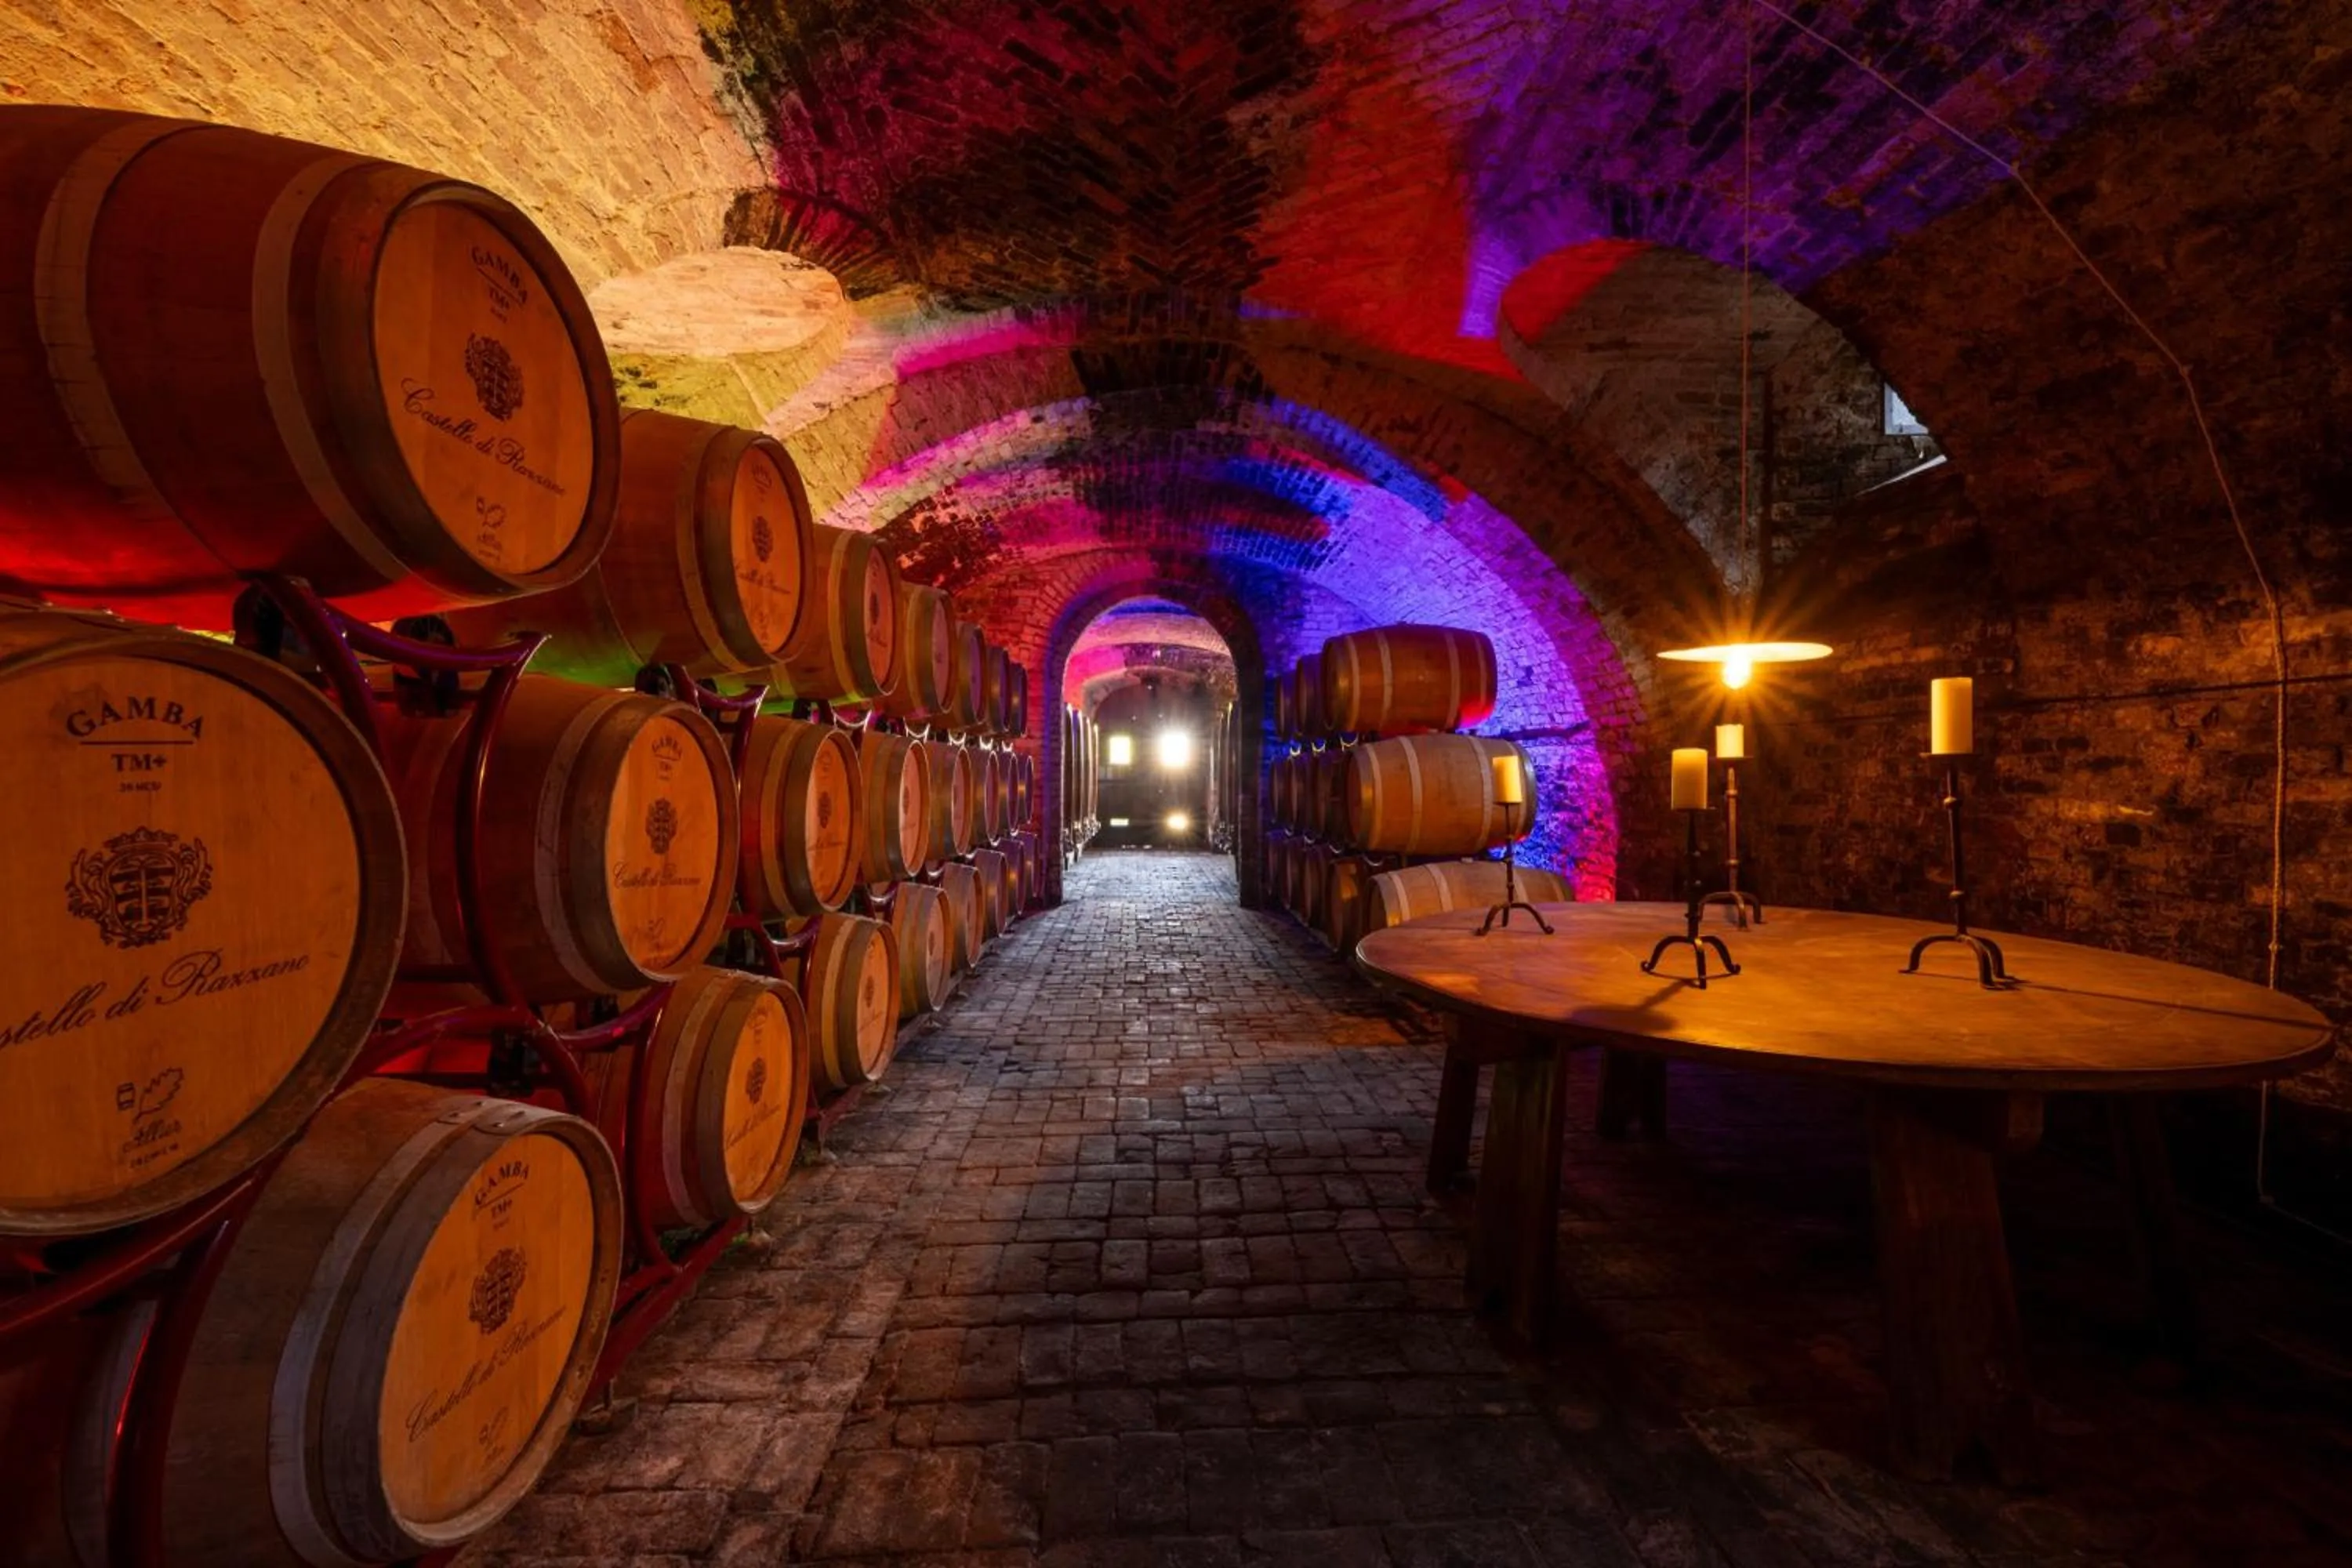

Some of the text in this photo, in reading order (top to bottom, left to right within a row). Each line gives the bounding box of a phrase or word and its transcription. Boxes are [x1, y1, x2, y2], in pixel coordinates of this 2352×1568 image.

[471, 245, 528, 304] GAMBA
[401, 377, 478, 444] Castello
[474, 434, 496, 456] di
[66, 696, 204, 739] GAMBA
[111, 753, 168, 771] TM+
[105, 975, 150, 1020] di
[156, 948, 310, 1004] Razzano
[474, 1160, 530, 1206] GAMBA
